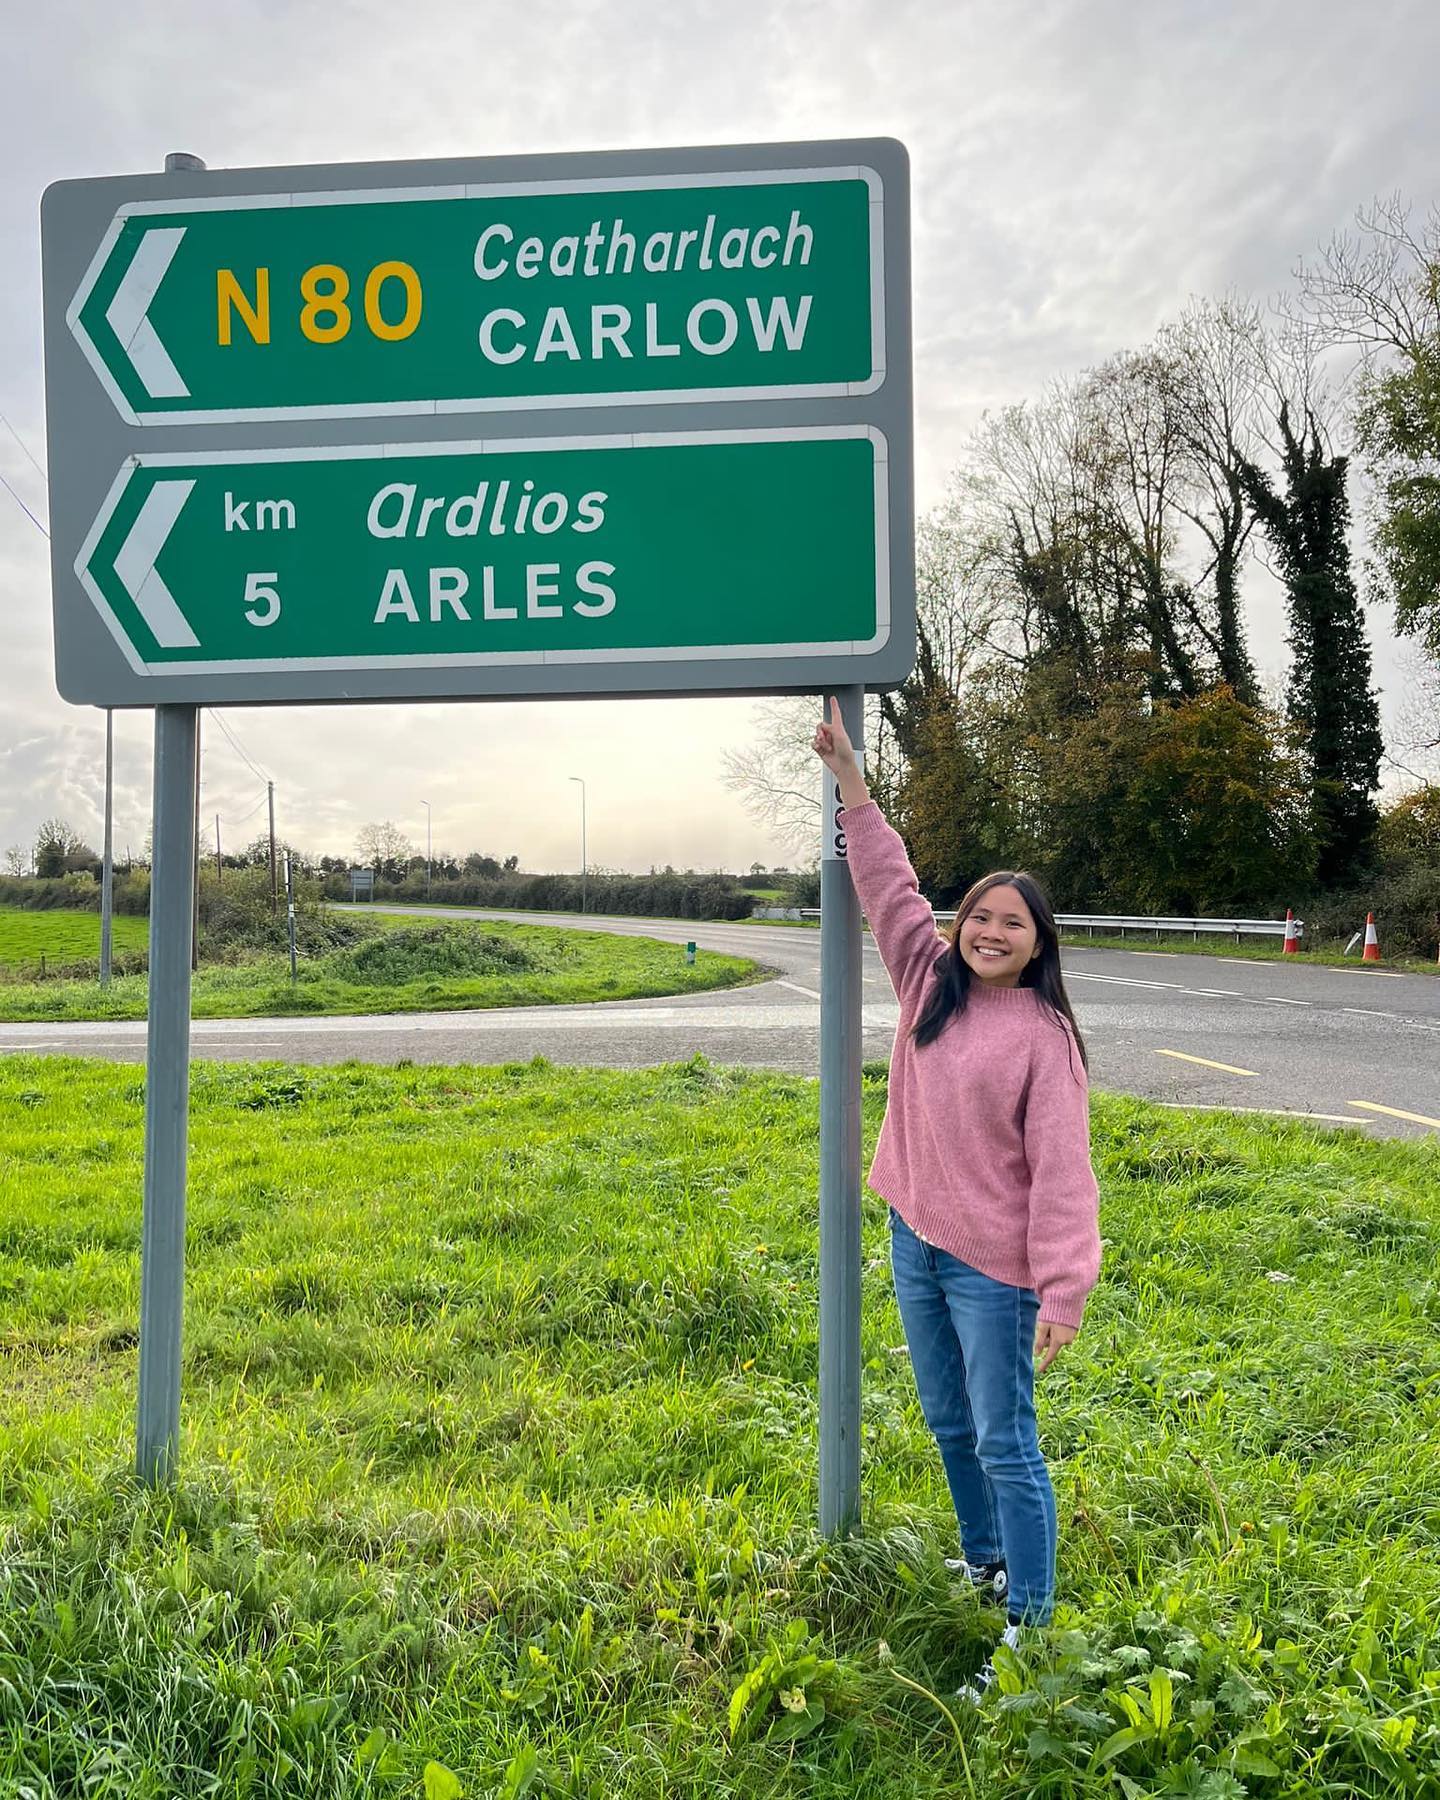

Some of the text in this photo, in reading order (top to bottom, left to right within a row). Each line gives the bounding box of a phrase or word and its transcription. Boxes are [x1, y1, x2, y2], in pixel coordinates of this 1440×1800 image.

[474, 210, 813, 281] Ceatharlach
[218, 261, 423, 345] N 80
[479, 295, 813, 365] CARLOW
[224, 491, 296, 532] km
[244, 572, 281, 627] 5
[373, 561, 616, 623] ARLES
